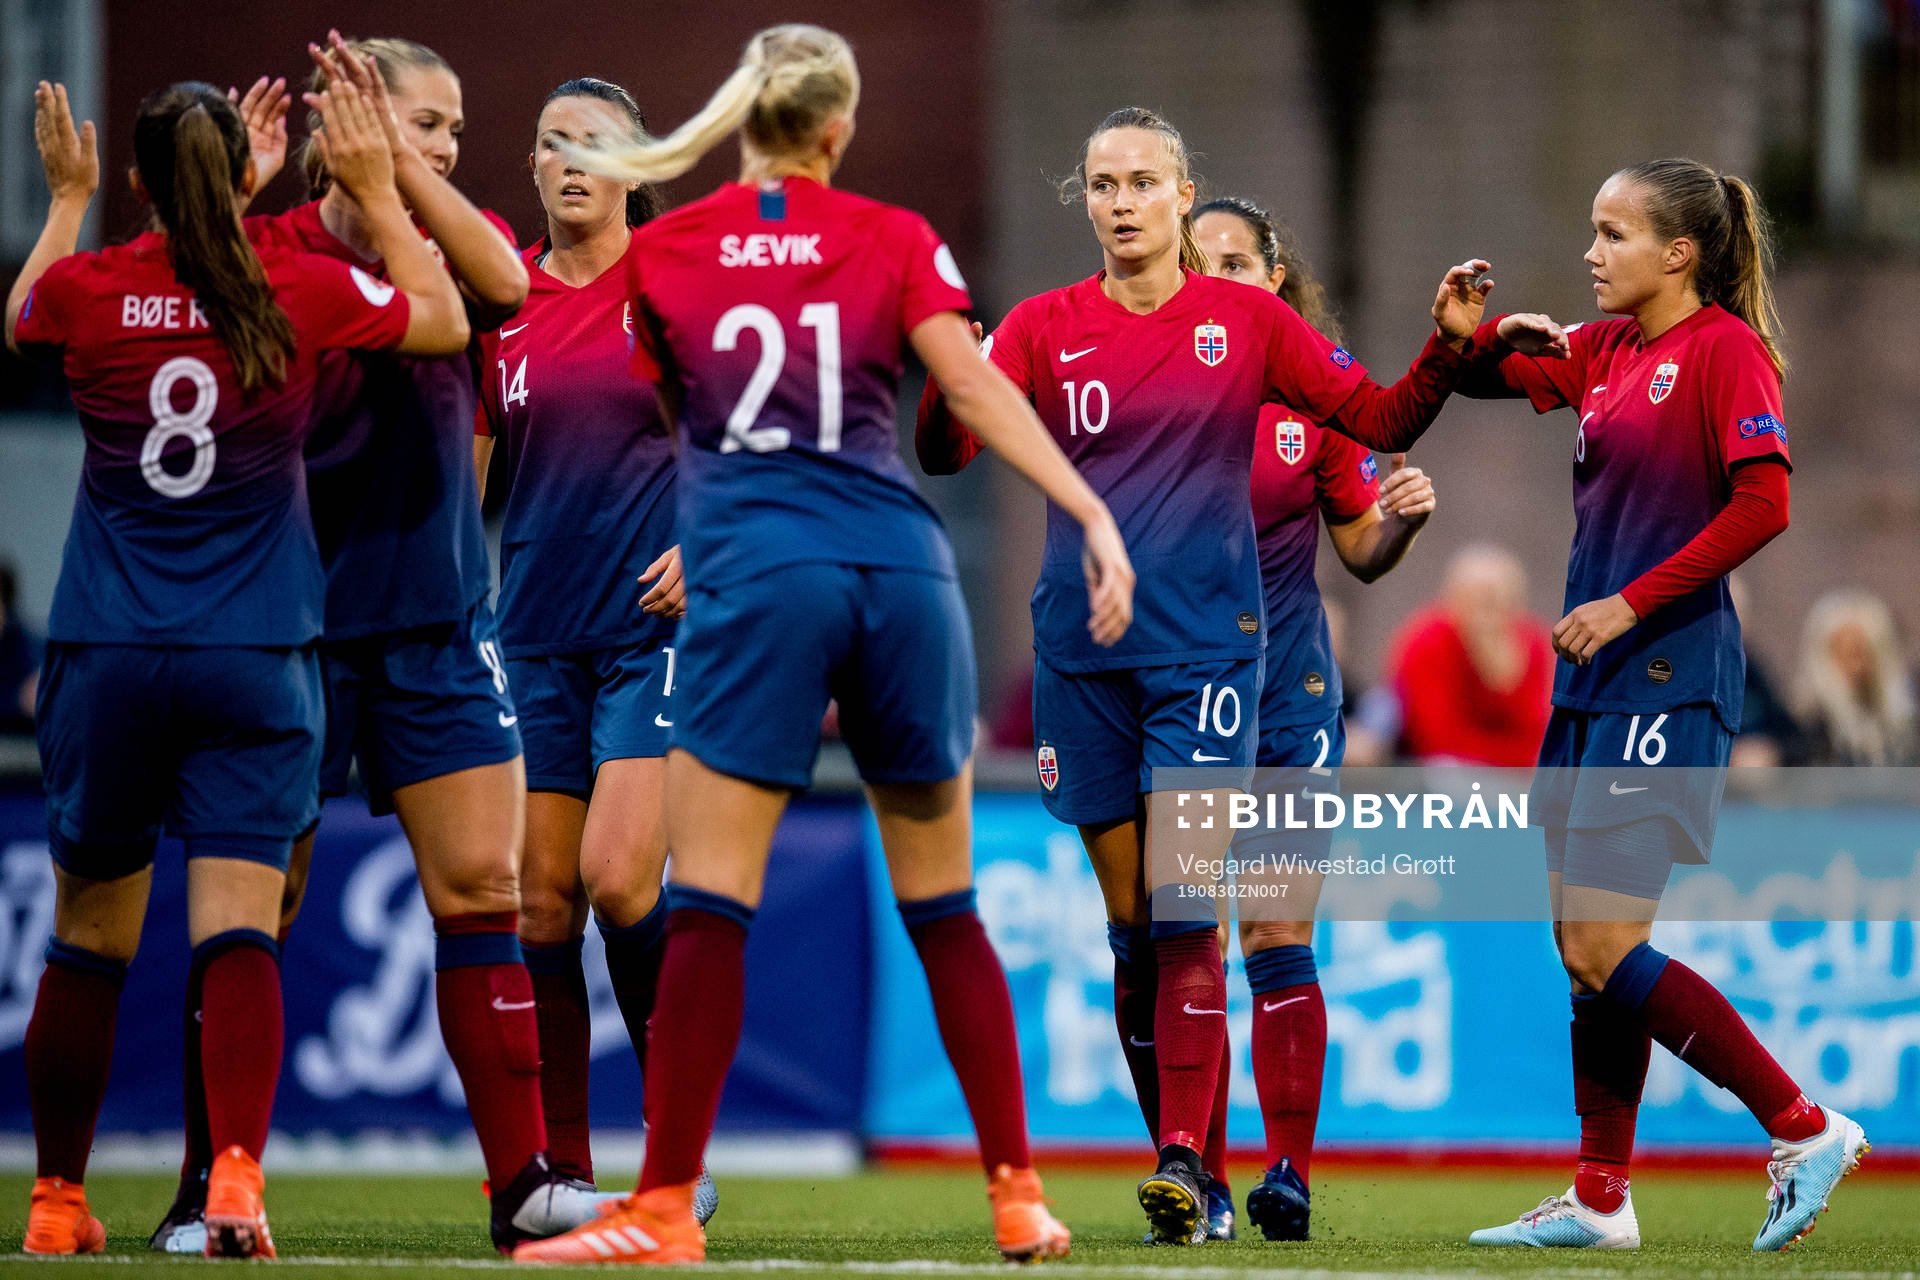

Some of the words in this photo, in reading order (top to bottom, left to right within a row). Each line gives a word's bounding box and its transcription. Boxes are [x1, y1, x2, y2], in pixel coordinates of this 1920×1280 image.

[719, 233, 823, 267] SÆVIK
[122, 295, 180, 328] BØE
[498, 354, 529, 413] 14
[712, 301, 843, 454] 21
[140, 356, 218, 498] 8
[1062, 380, 1110, 436] 10
[1574, 411, 1596, 463] 6
[662, 647, 676, 696] 1
[1198, 683, 1240, 737] 10
[1308, 728, 1332, 777] 2
[1622, 713, 1669, 766] 16
